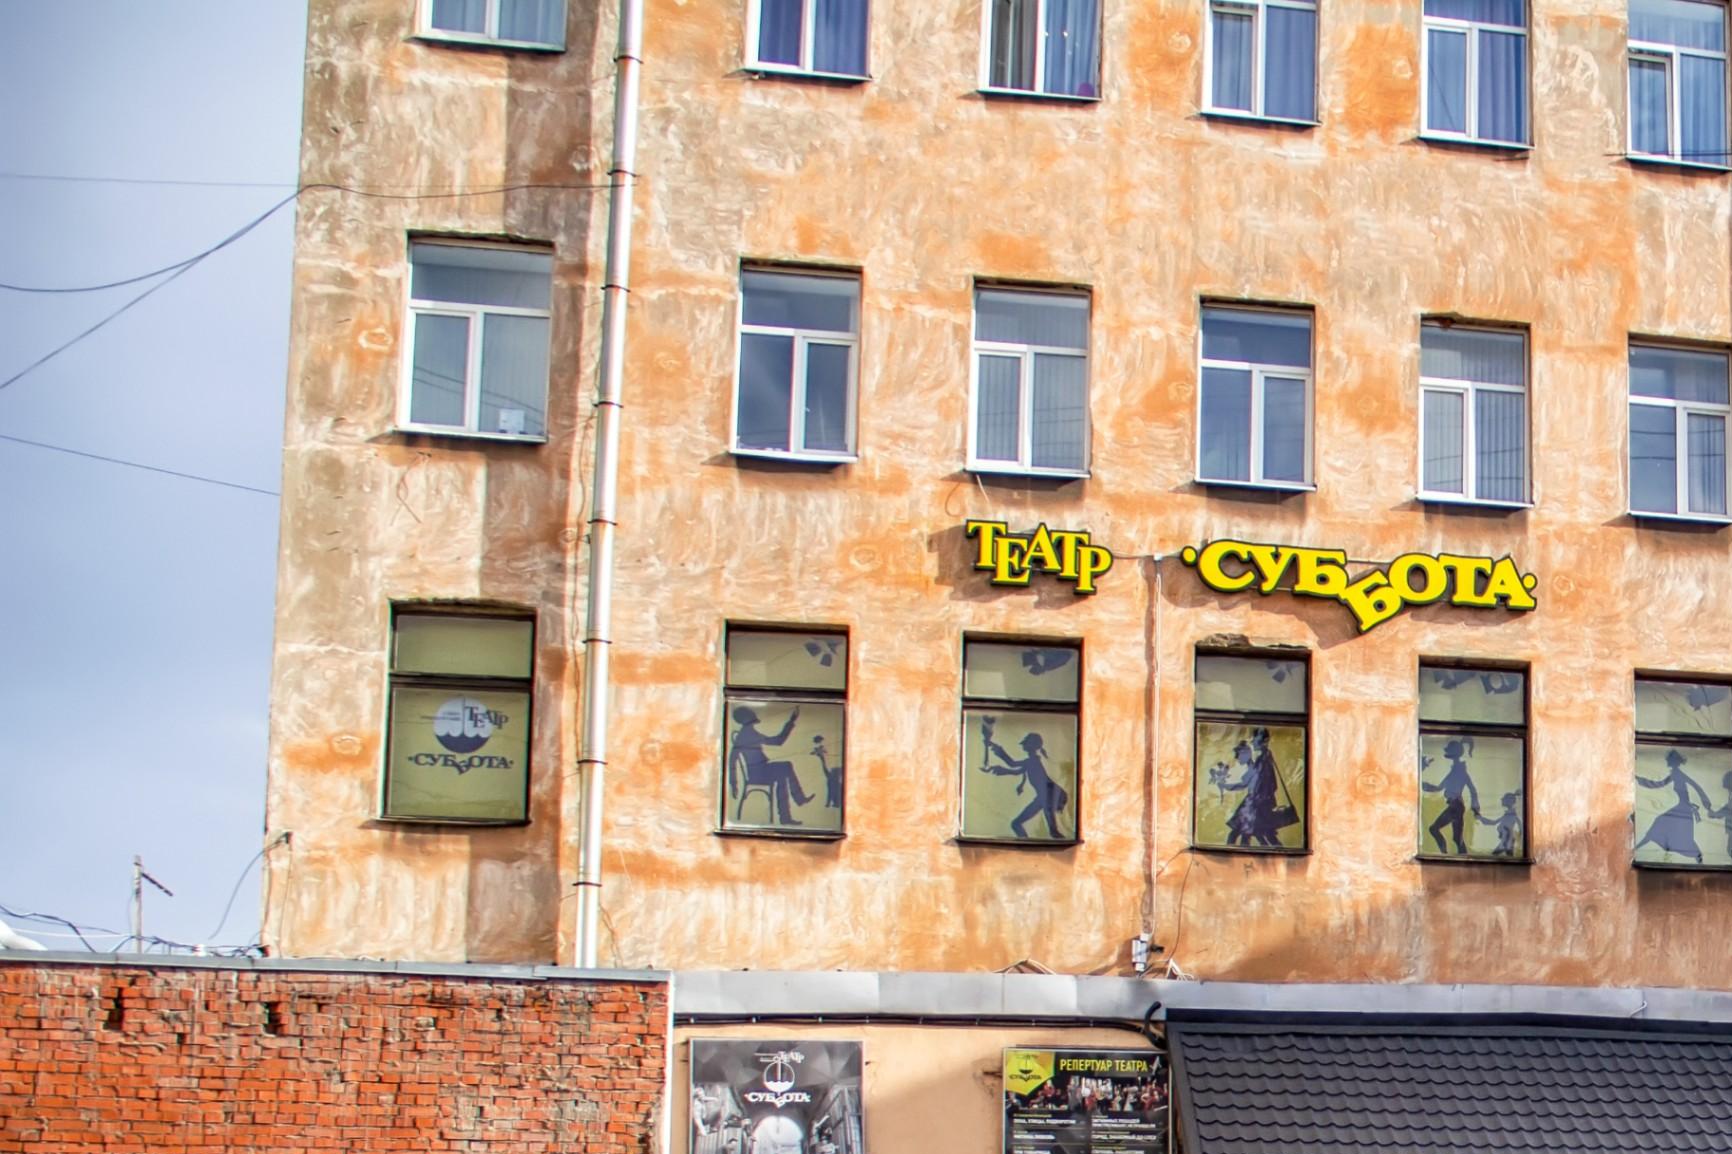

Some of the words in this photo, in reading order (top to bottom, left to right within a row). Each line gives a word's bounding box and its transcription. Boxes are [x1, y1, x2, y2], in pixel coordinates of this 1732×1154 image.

[966, 519, 1113, 594] ТЕАТР
[464, 706, 509, 730] ТЕАТР
[1059, 1058, 1113, 1071] РЕПЕРТУАР
[1115, 1059, 1148, 1072] ТЕАТРА
